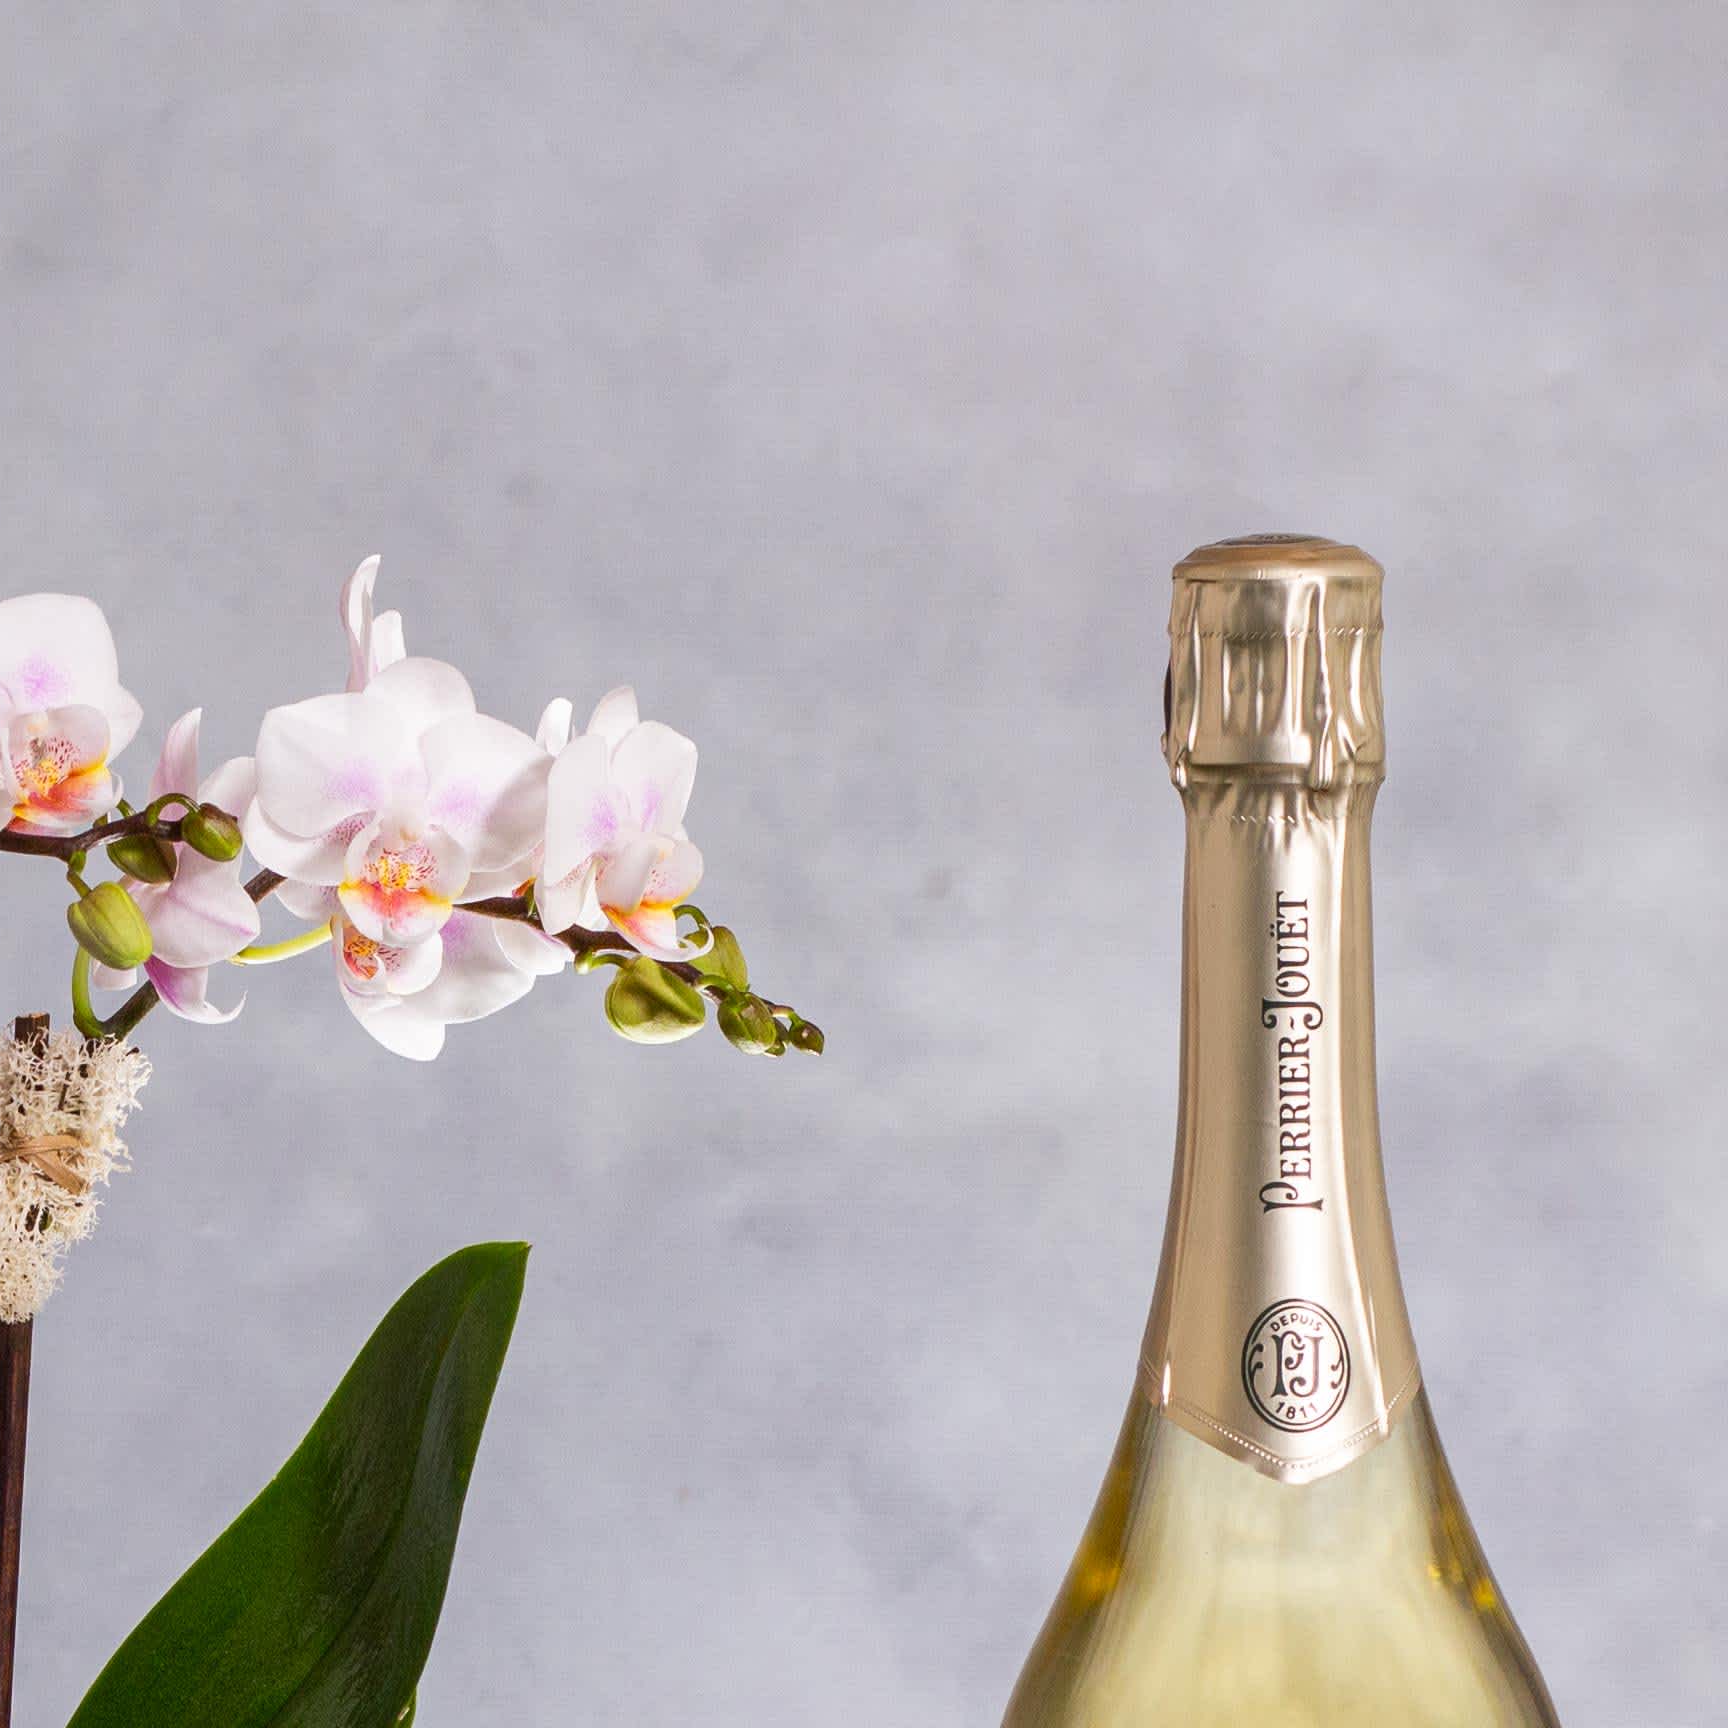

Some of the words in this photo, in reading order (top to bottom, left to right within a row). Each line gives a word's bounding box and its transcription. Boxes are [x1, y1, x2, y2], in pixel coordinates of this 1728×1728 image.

[1258, 890, 1325, 1212] PERRIER-JOUËT
[1270, 1312, 1324, 1332] DEPUIS
[1275, 1401, 1318, 1420] 1811
